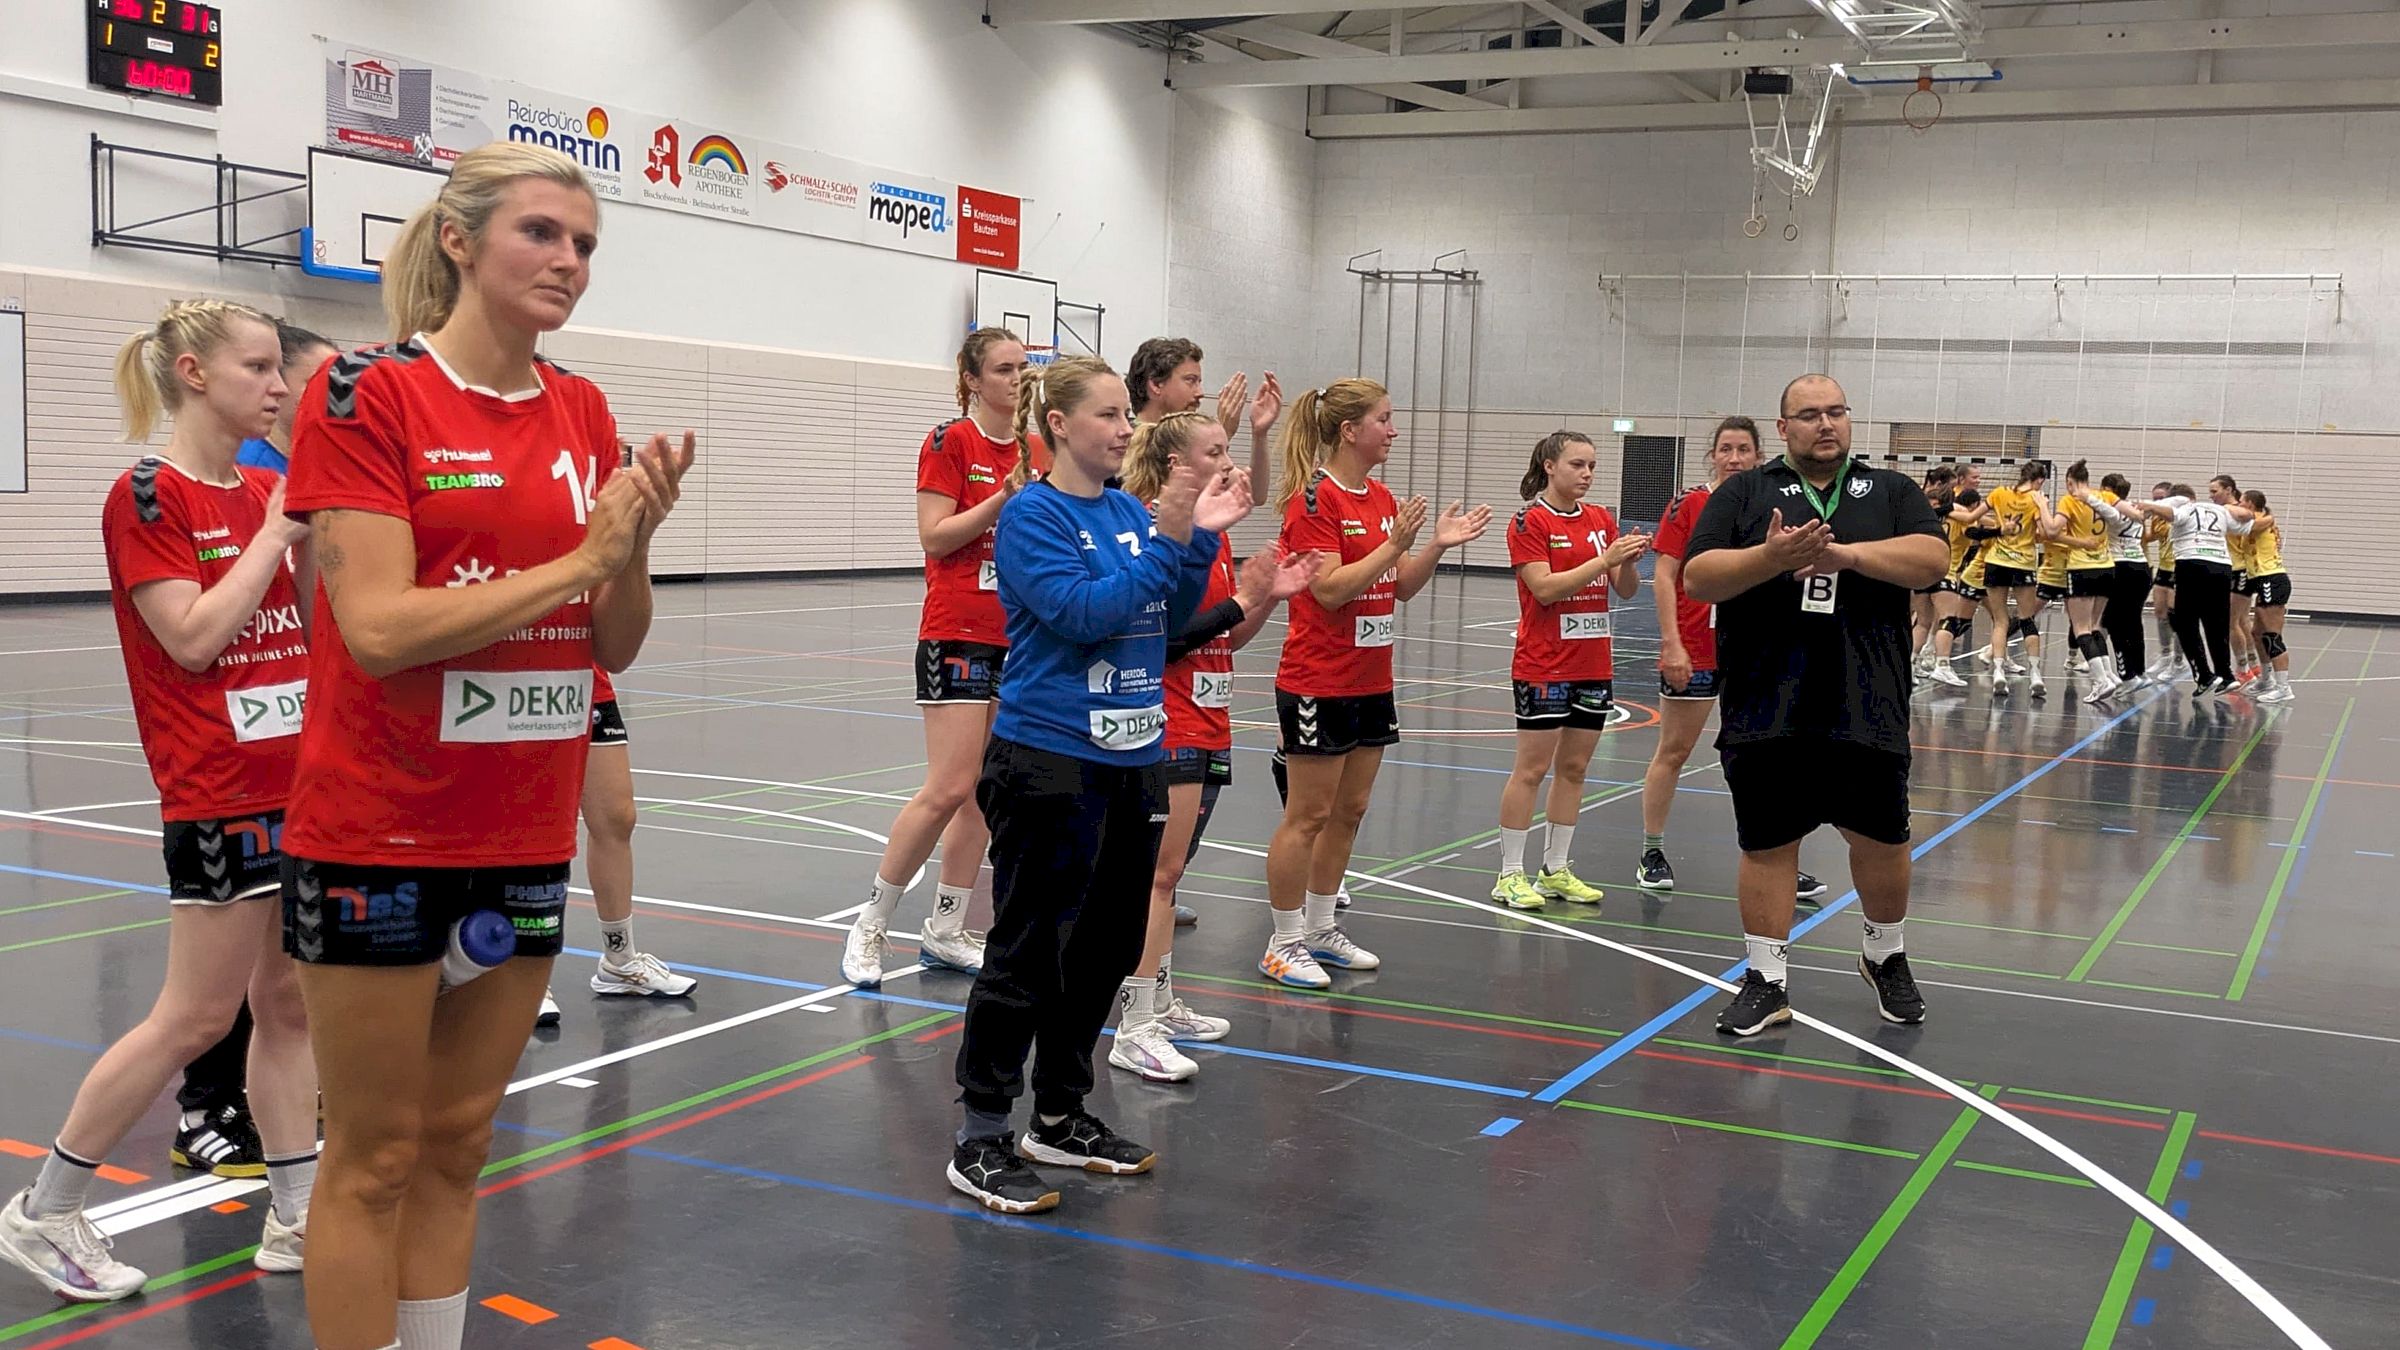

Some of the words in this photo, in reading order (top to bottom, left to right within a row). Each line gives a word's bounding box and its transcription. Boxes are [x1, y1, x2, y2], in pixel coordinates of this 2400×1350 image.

[152, 1, 166, 24] 2
[208, 20, 218, 33] G
[106, 23, 114, 45] 1
[205, 44, 219, 68] 2
[128, 61, 191, 95] 60:00
[352, 69, 393, 96] MH
[352, 88, 393, 105] HARTMANN
[508, 99, 582, 133] Reisebüro
[688, 164, 749, 187] REGENBOGEN
[695, 180, 743, 200] APOTHEKE
[973, 208, 1018, 228] Kreissparkasse
[973, 221, 999, 237] Bautzen
[426, 474, 504, 491] TEAMBRO
[1779, 483, 1803, 497] TR
[2189, 507, 2222, 533] 12
[198, 545, 241, 562] EAMBRO
[1808, 575, 1833, 603] B
[218, 653, 249, 667] DEIN
[509, 681, 585, 718] DEKRA
[507, 721, 568, 732] Niederlassung
